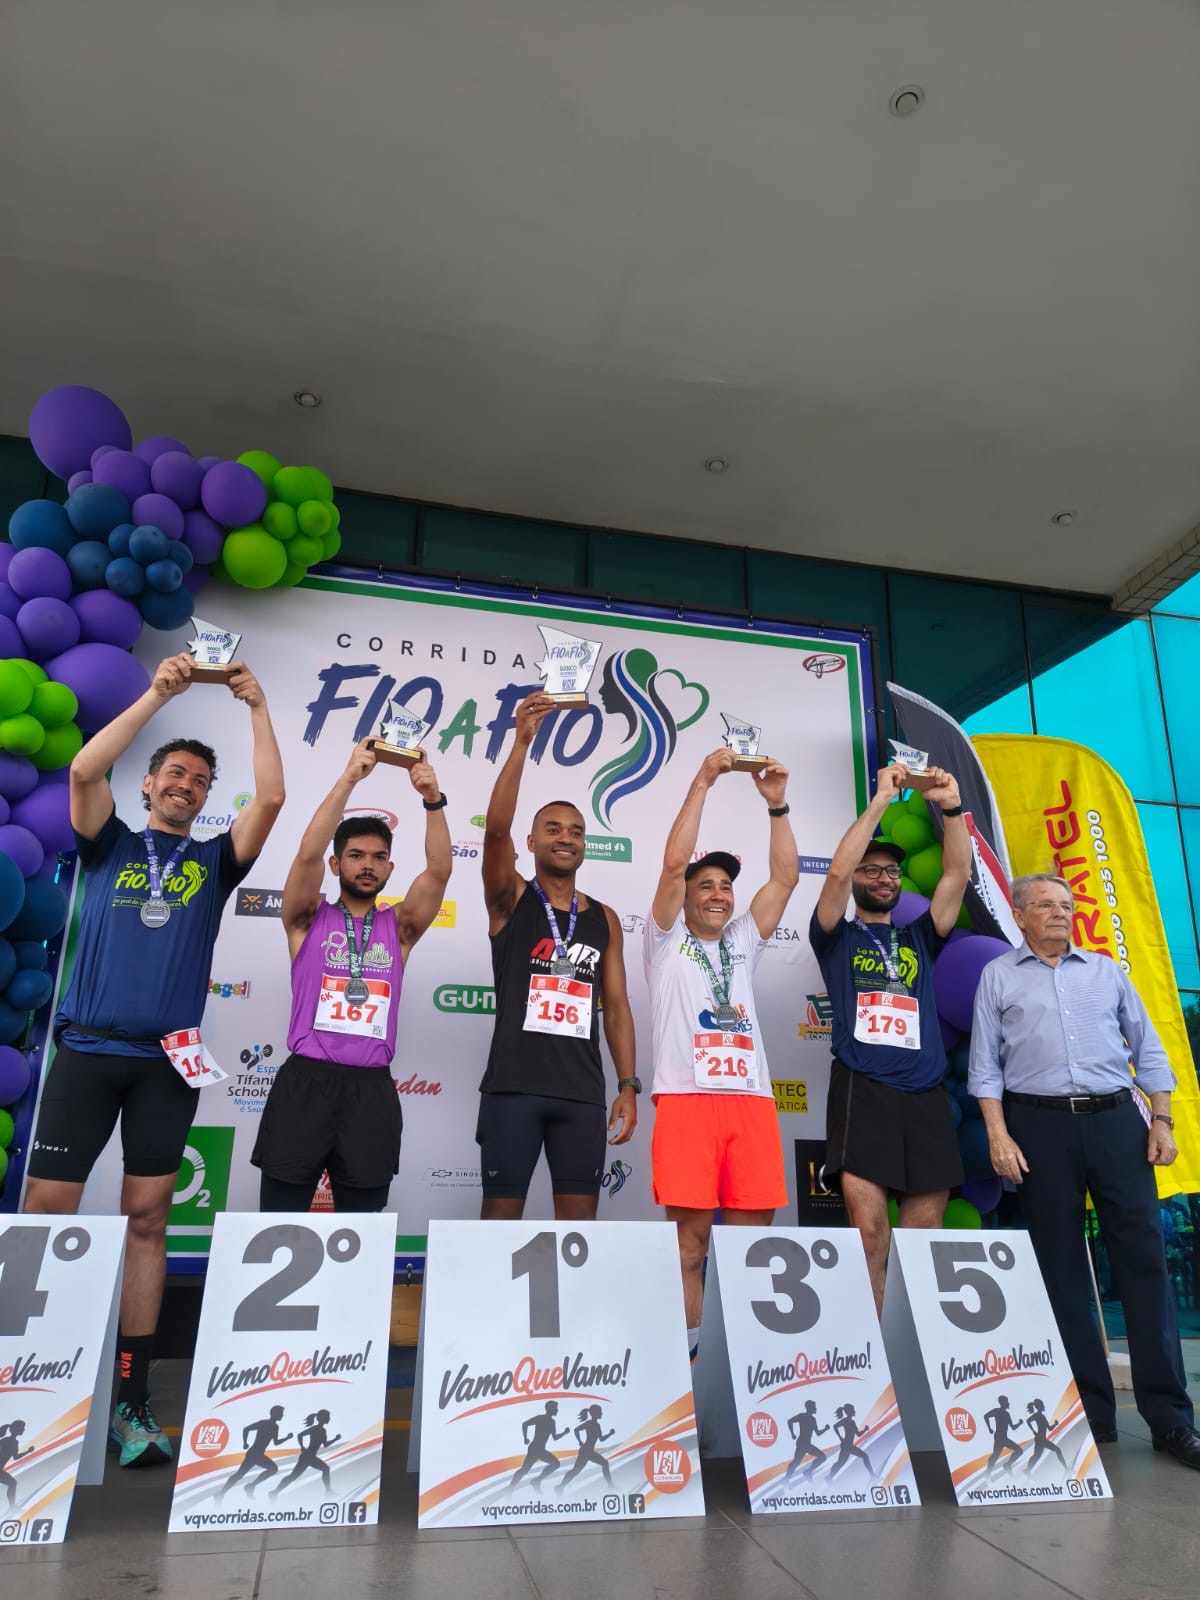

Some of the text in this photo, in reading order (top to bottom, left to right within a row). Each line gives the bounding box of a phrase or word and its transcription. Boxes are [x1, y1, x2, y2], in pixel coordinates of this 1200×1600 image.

[337, 633, 525, 669] CORRIDA
[303, 663, 603, 767] FIO A FIO
[195, 814, 235, 826] ncol
[1086, 809, 1110, 864] 1000
[451, 845, 478, 859] São
[803, 860, 832, 870] INTERP
[1043, 779, 1113, 960] RATEL
[115, 870, 147, 890] FIO
[1101, 868, 1118, 908] 655
[853, 955, 874, 972] FIO
[320, 992, 334, 1003] 6K
[529, 991, 542, 1003] 6K
[330, 1001, 378, 1024] 167
[537, 1000, 579, 1025] 156
[857, 1008, 870, 1020] 6K
[806, 1032, 832, 1040] ECON
[867, 1015, 907, 1036] 179
[695, 1049, 709, 1061] 6K
[707, 1056, 748, 1078] 216
[227, 1086, 270, 1097] Schok
[0, 1347, 83, 1385] eVamo!
[762, 1490, 867, 1511] vqvcorridas.com.br
[967, 1483, 1064, 1503] vqvcorridas.com.br
[184, 1507, 314, 1529] vqvcorridas.com.br
[481, 1499, 597, 1520] vqvcorridas.com.br
